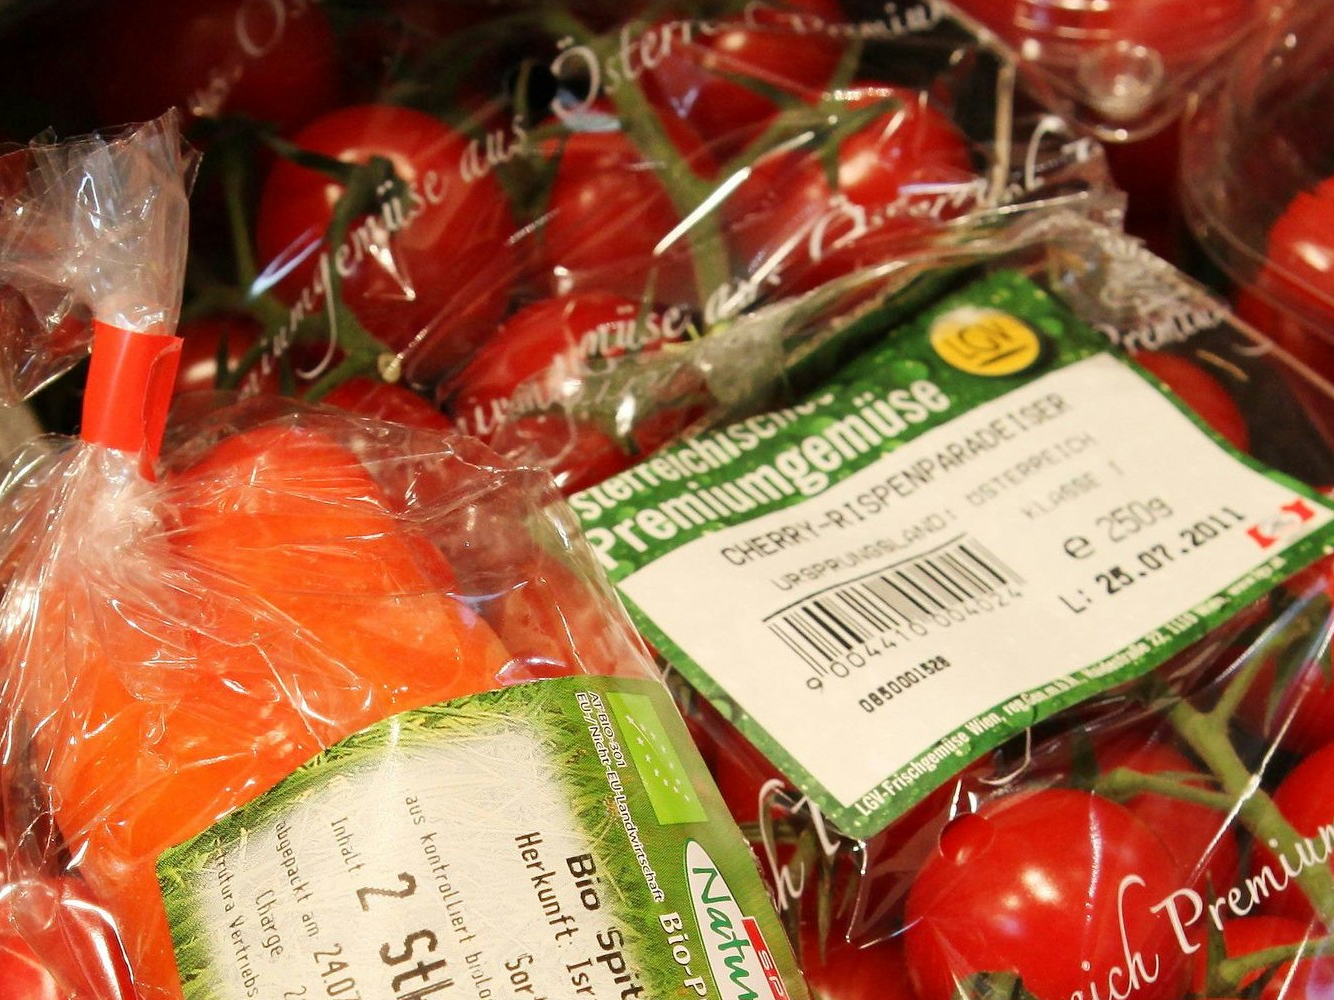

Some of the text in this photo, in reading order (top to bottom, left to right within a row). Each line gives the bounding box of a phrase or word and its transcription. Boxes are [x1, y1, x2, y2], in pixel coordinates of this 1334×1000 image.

[458, 113, 525, 183] aus
[583, 379, 951, 573] Premiumgemüse
[720, 392, 1070, 568] CHERRY-RISPENPARADEISER
[1058, 588, 1094, 616] L:
[1094, 505, 1247, 597] 25.07.2011
[1096, 496, 1174, 545] 250g
[805, 677, 824, 694] 9
[828, 620, 929, 681] 004410
[858, 654, 952, 714] 0850001528
[854, 729, 971, 818] LGV-Frischgemüse
[965, 703, 1008, 742] Wien,
[274, 819, 315, 905] abgepackt
[355, 871, 418, 913] 2
[404, 794, 426, 826] aus
[419, 831, 478, 944] kontrolliert
[514, 831, 580, 949] Herkunft:
[565, 853, 602, 912] Bio
[228, 913, 260, 999] Vertriebs
